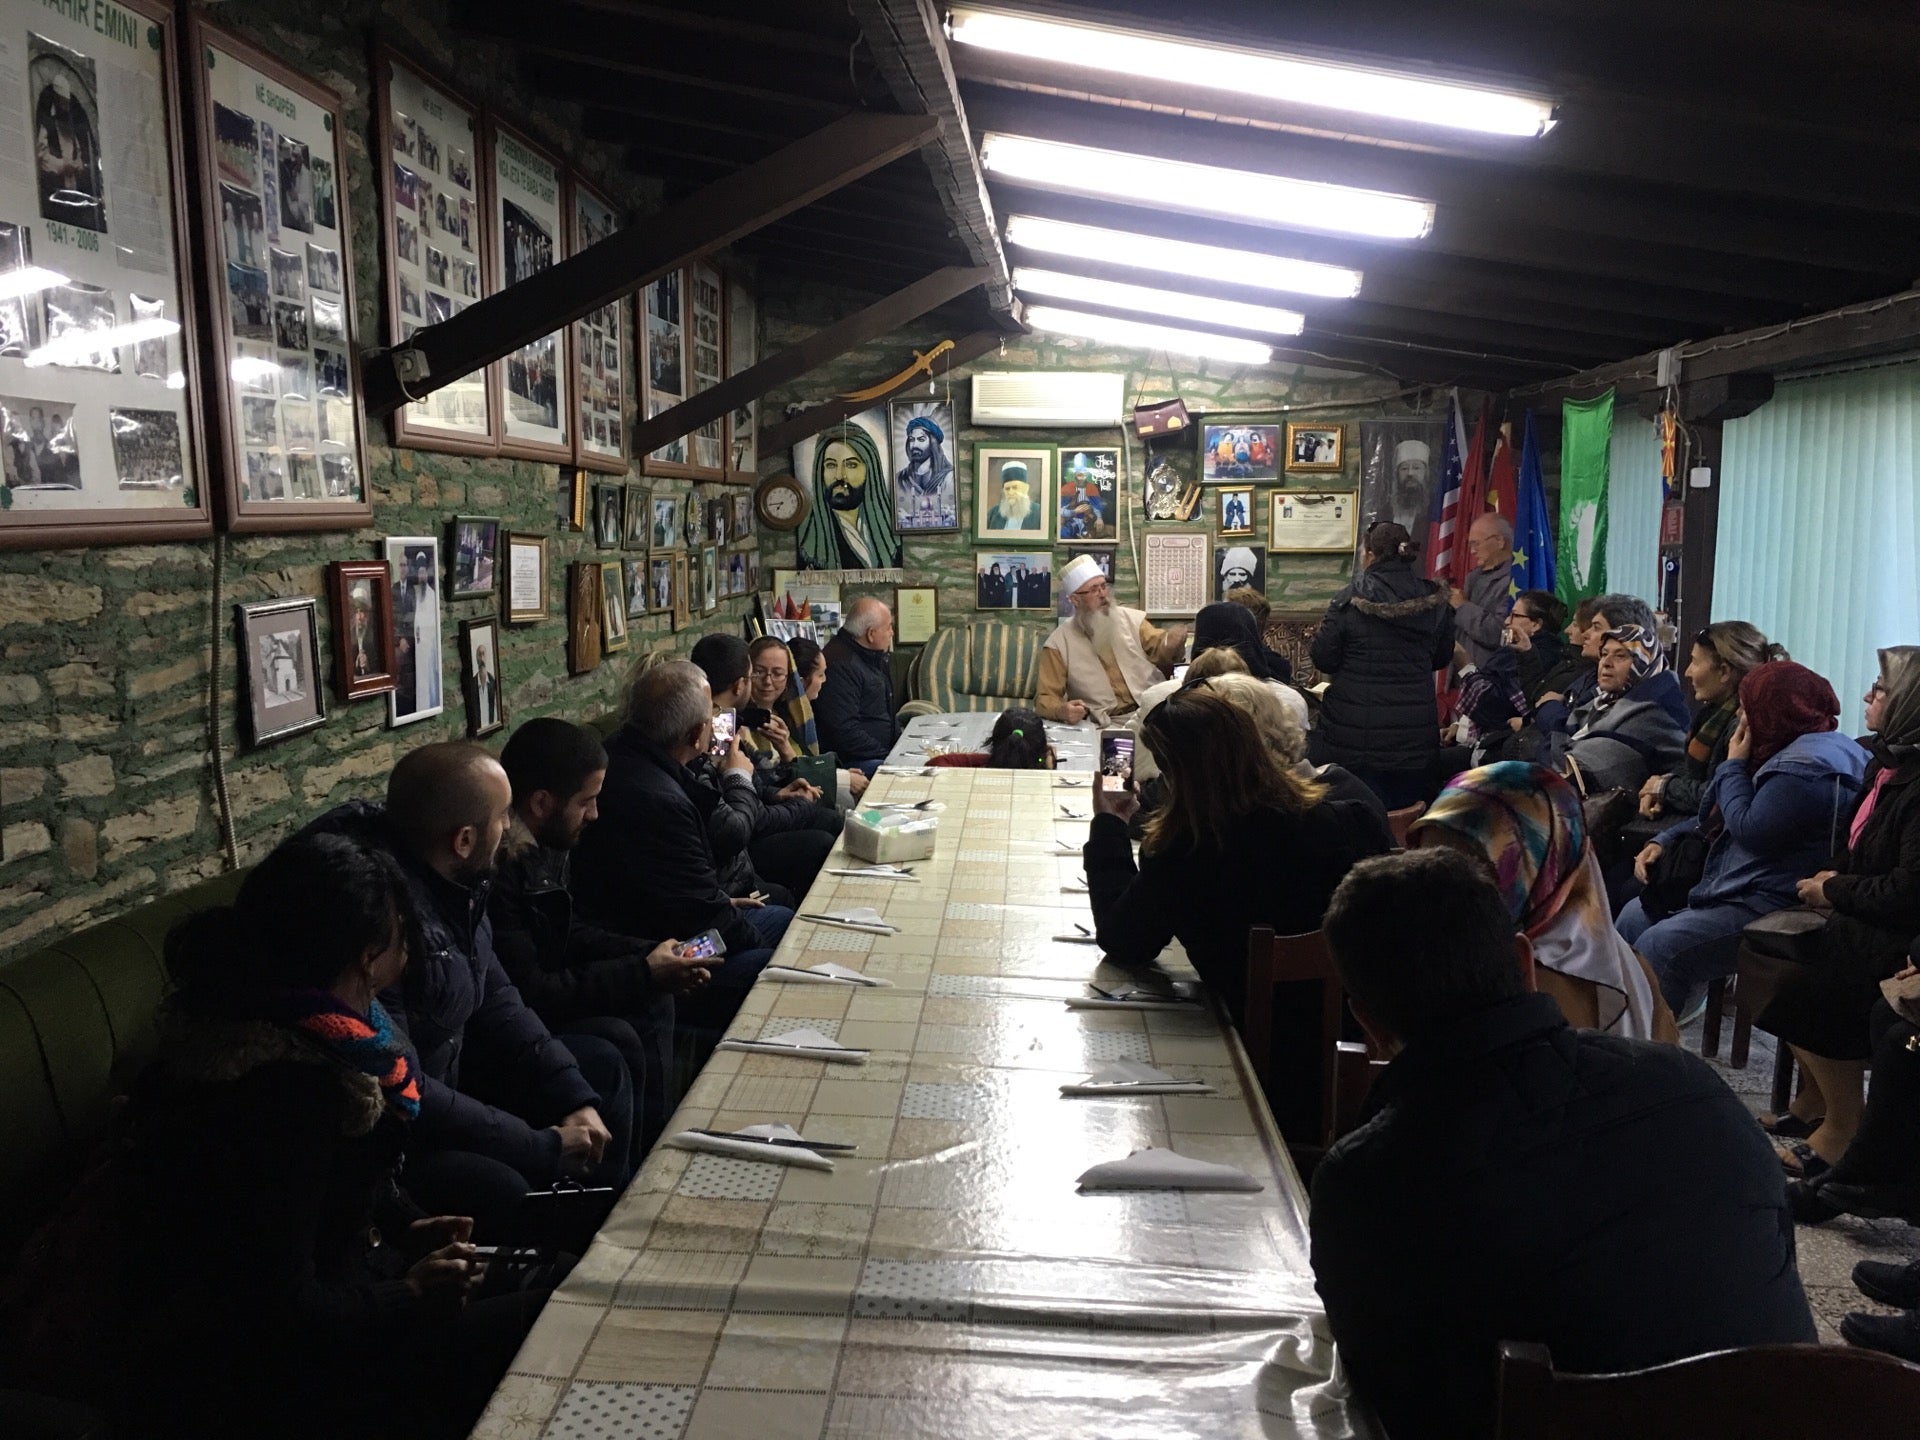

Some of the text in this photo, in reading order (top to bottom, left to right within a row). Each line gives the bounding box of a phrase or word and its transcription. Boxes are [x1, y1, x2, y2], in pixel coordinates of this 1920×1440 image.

[42, 0, 138, 49] AHIR EMINI
[46, 221, 68, 244] 1941
